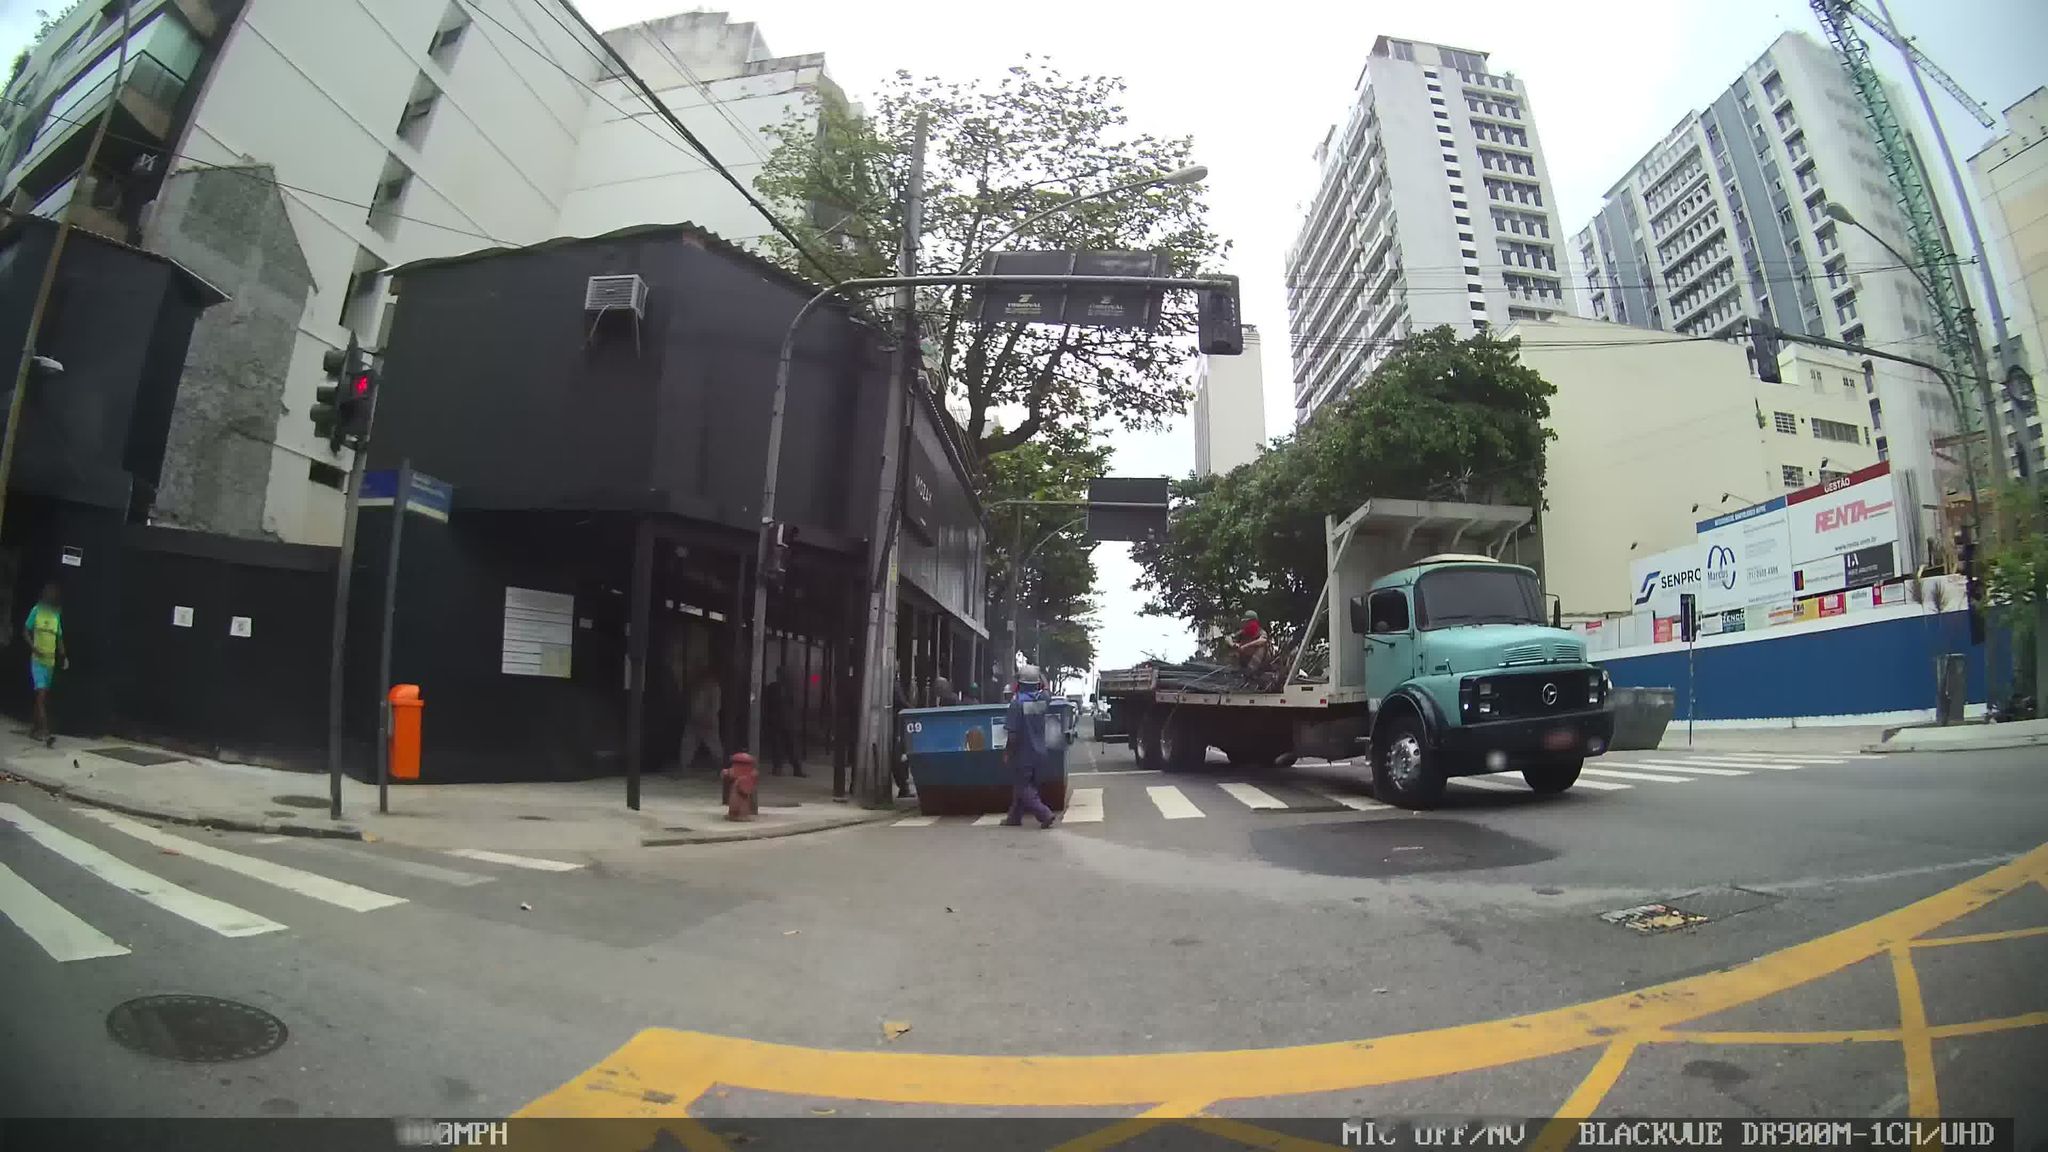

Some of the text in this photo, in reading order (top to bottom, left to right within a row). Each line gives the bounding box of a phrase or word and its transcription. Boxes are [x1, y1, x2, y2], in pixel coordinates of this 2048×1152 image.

[1824, 477, 1851, 493] GESTÃO
[1815, 499, 1868, 534] RENTA
[1707, 569, 1729, 583] Marcus
